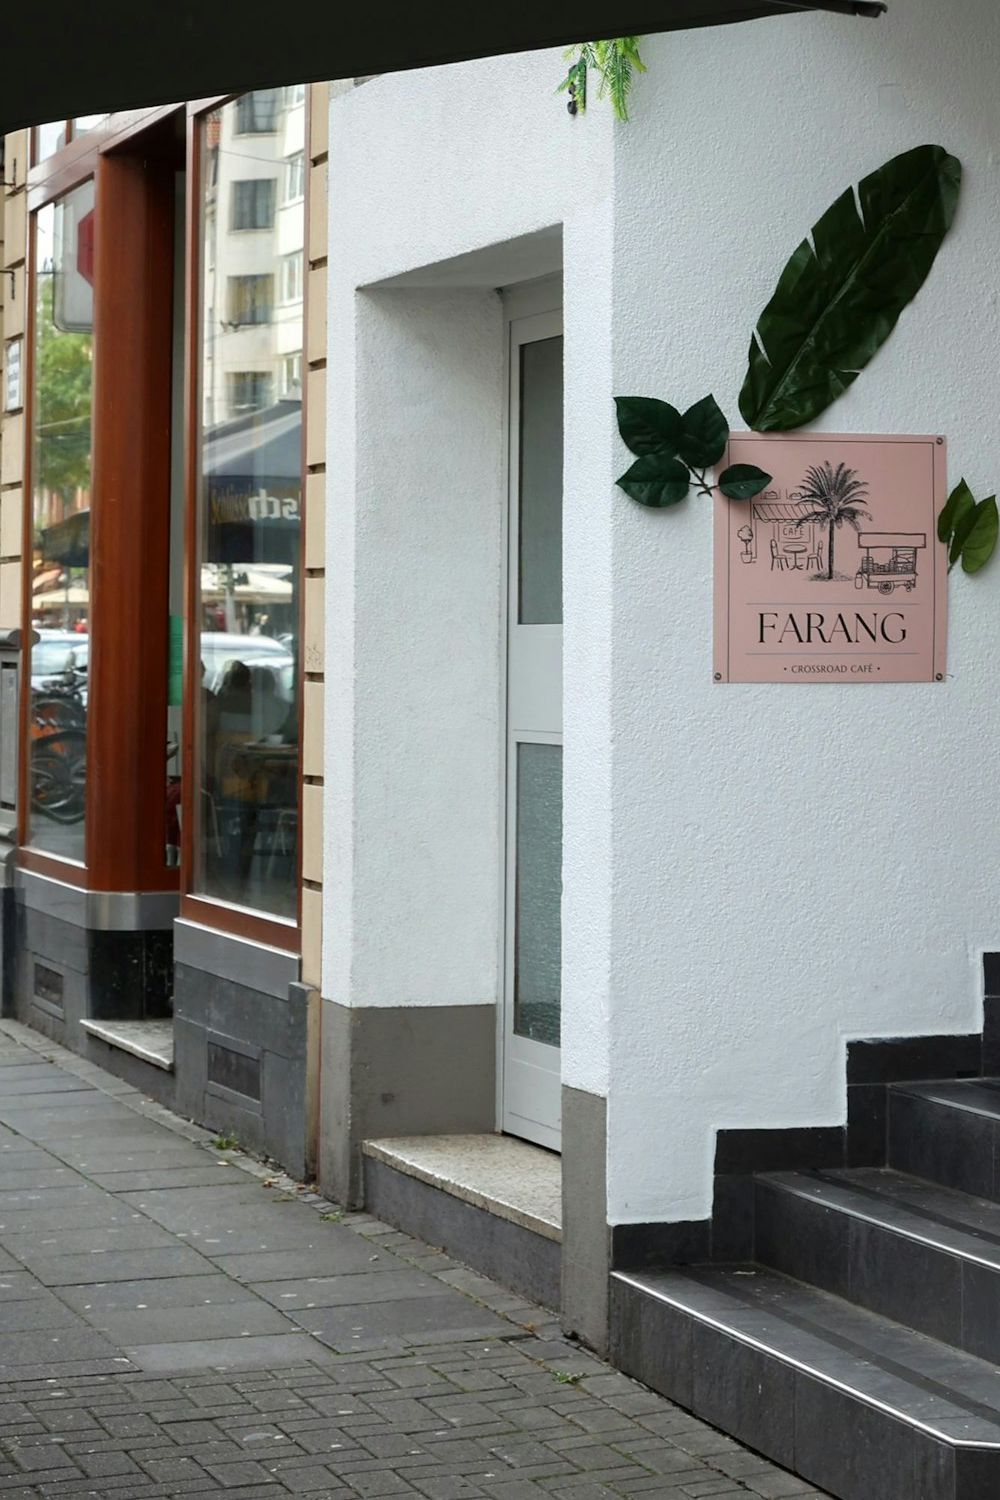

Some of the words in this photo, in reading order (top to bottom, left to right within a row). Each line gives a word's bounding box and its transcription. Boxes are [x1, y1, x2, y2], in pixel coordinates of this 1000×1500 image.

[758, 612, 907, 644] FARANG
[790, 664, 848, 674] CROSSROAD
[850, 663, 873, 674] CAFÉ
